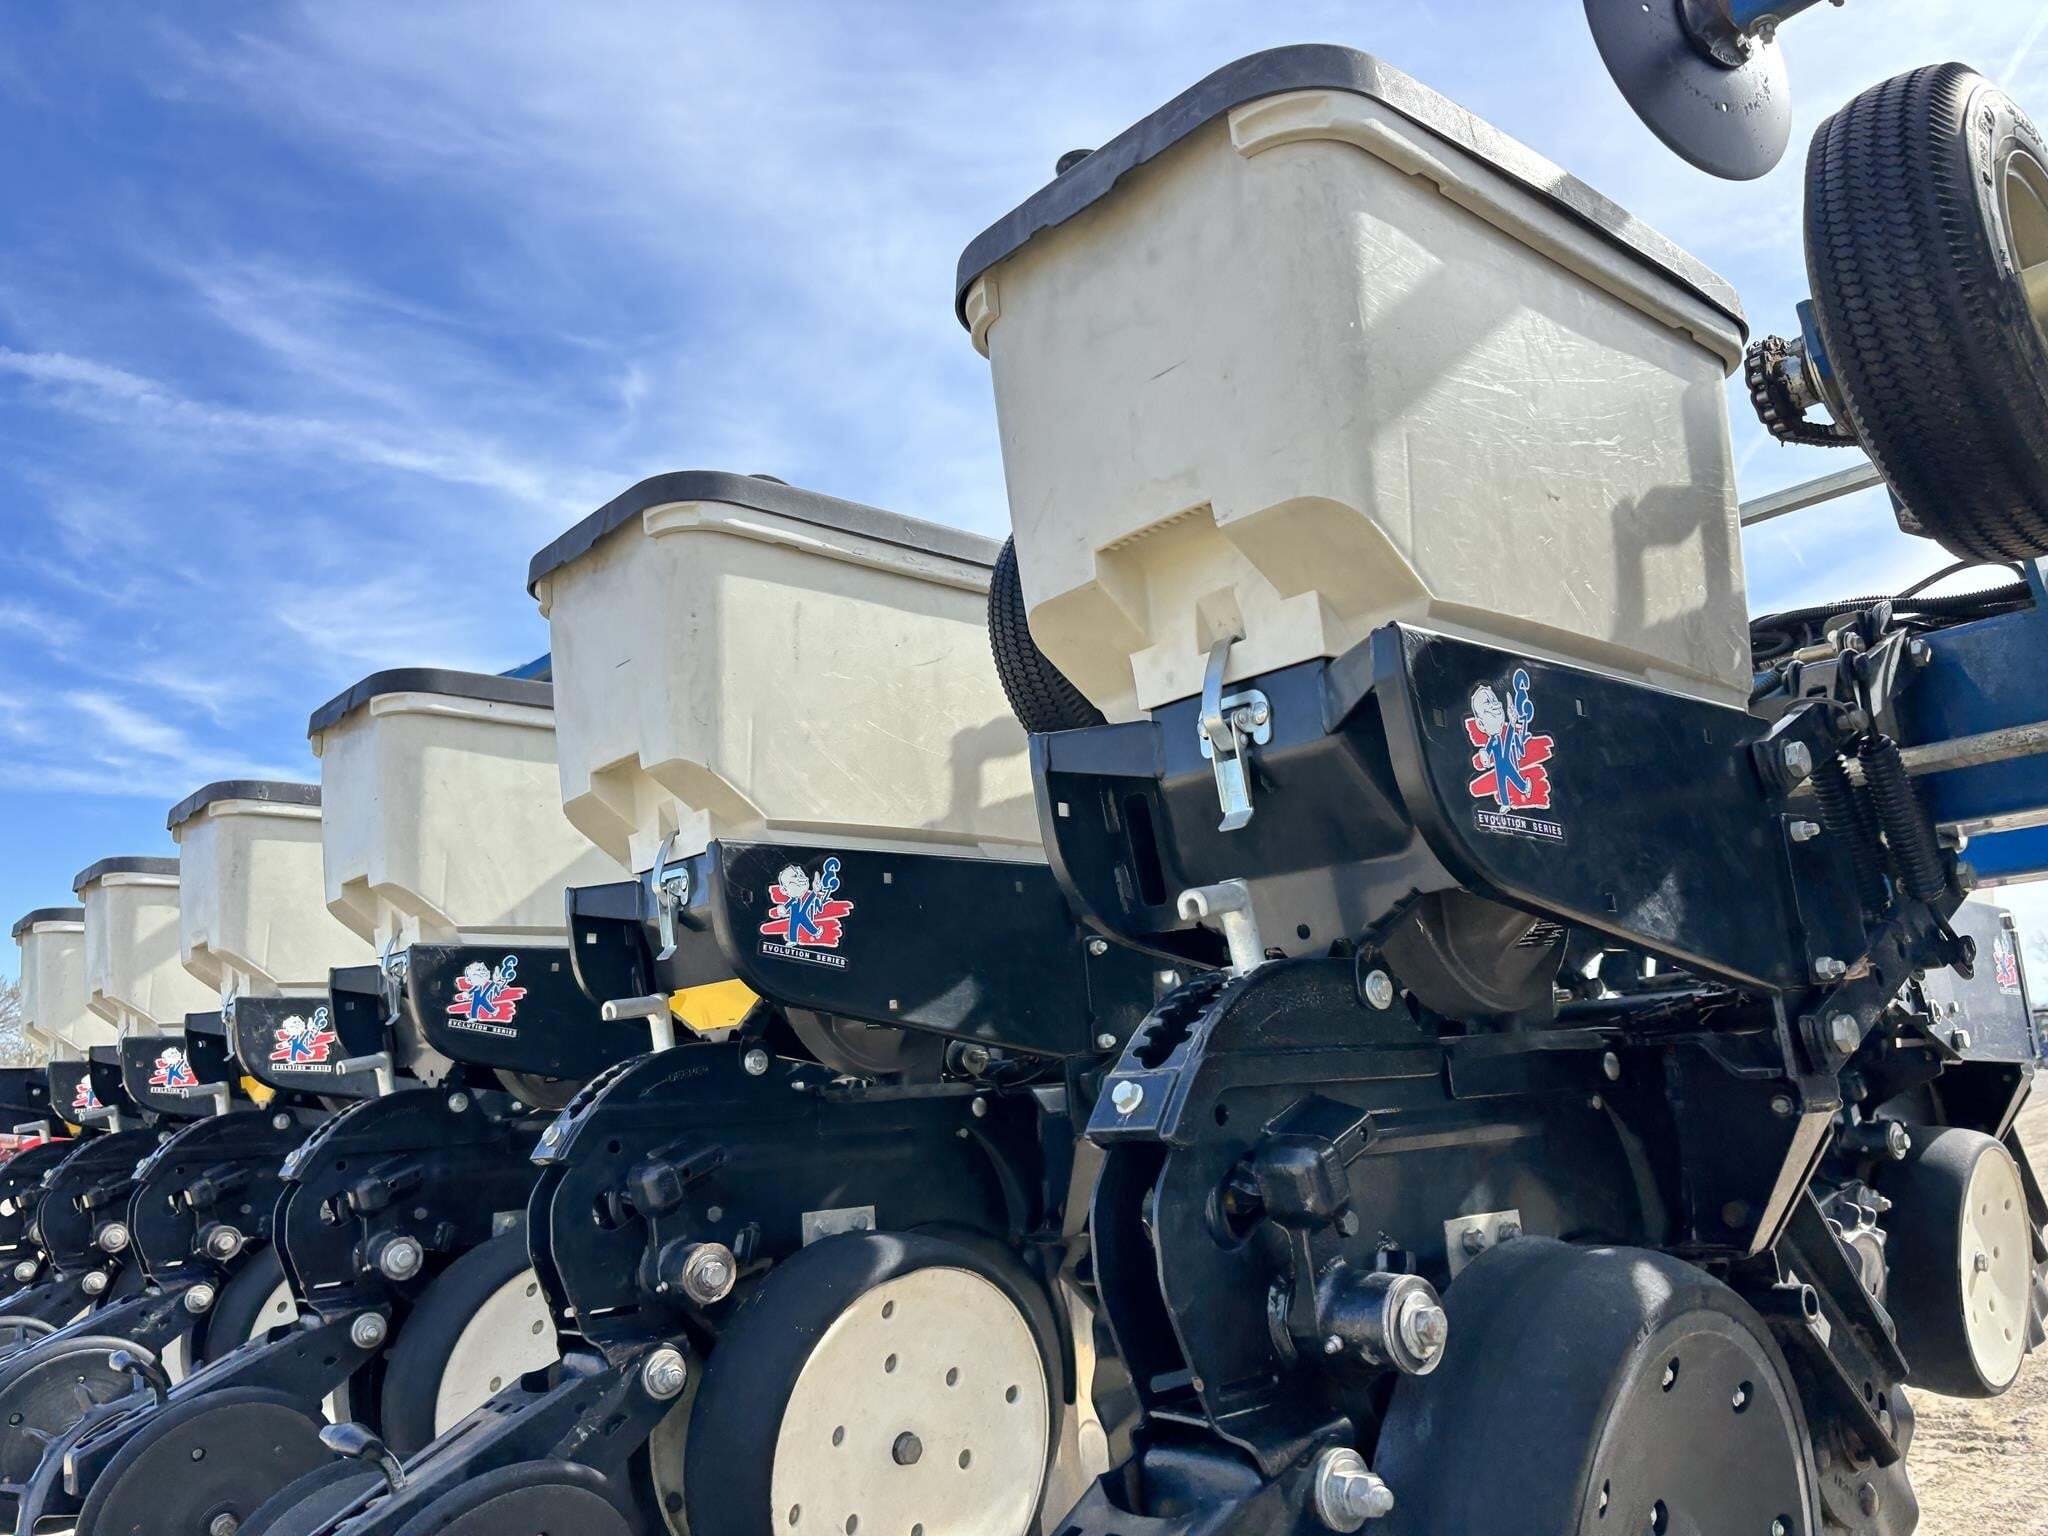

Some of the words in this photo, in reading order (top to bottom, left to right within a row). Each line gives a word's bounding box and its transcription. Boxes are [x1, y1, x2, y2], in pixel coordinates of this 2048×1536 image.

[1478, 813, 1527, 830] EVOLUTION
[1532, 822, 1563, 836] SERIES
[762, 943, 810, 959] EVOLUTION
[816, 954, 846, 966] SERIES
